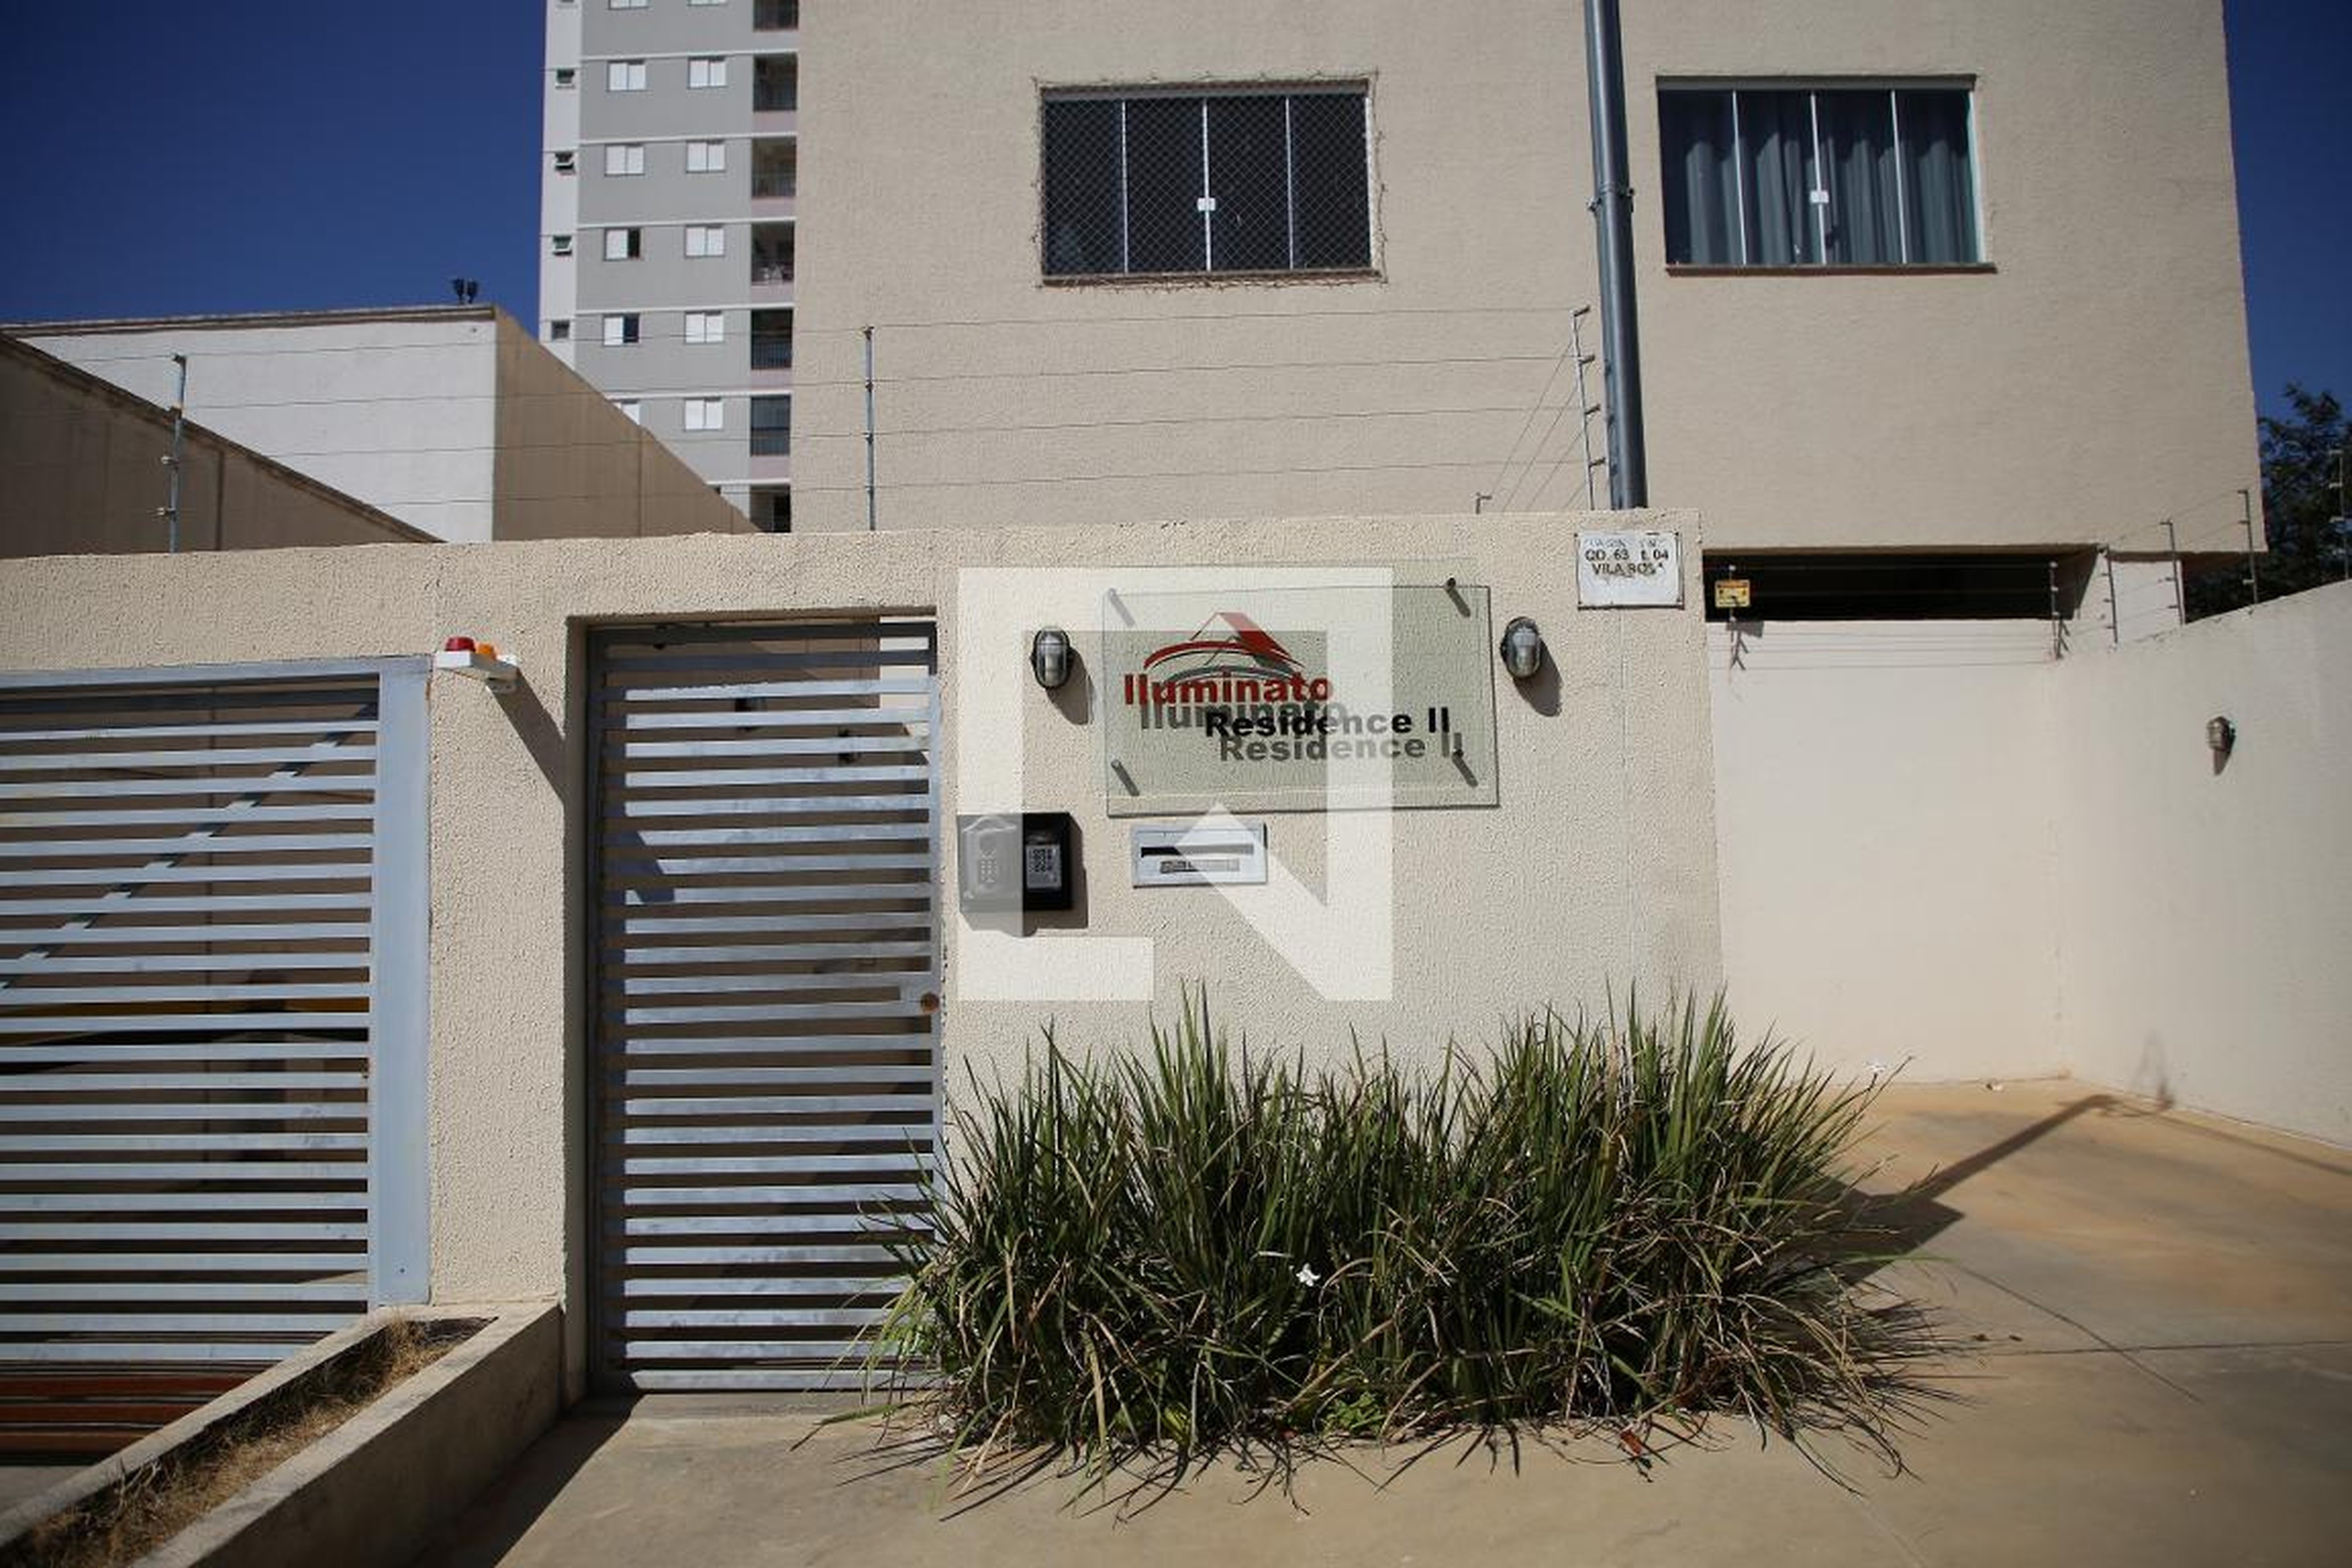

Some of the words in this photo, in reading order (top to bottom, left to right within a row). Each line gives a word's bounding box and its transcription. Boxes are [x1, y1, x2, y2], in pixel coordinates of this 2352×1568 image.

[1613, 549, 1629, 560] 63
[1592, 563, 1624, 575] VILA
[1124, 673, 1333, 706] Iluminato
[1205, 709, 1412, 736] Residence
